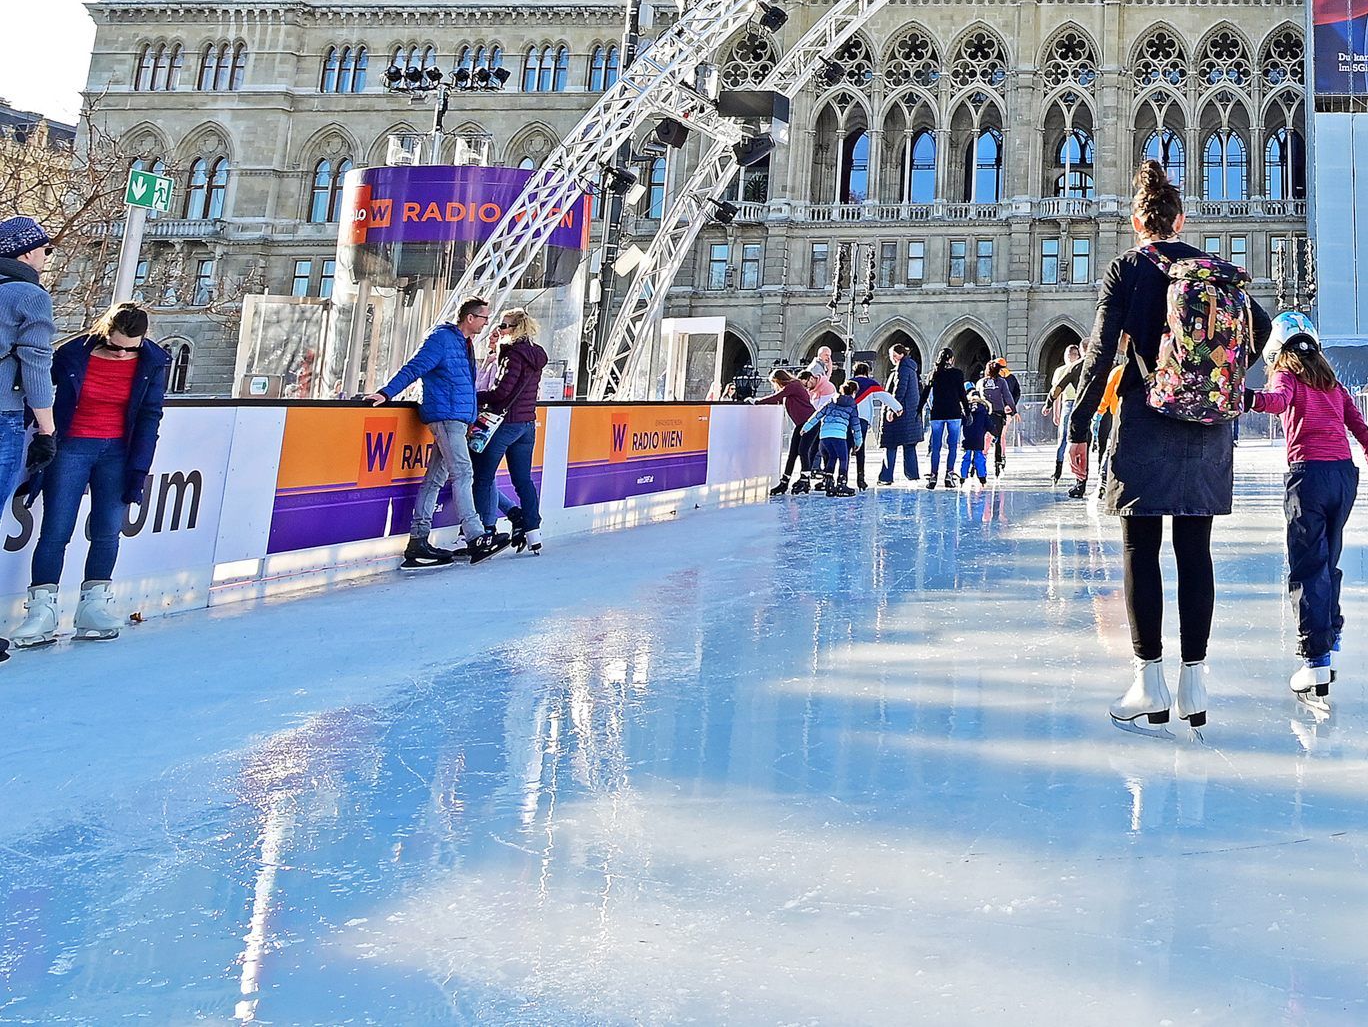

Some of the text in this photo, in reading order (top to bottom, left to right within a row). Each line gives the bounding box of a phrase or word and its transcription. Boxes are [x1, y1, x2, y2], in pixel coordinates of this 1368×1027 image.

[1338, 52, 1351, 62] Du
[1338, 63, 1350, 72] Im
[402, 201, 502, 223] RADIO
[612, 423, 683, 452] W RADIO WIEN
[366, 432, 394, 472] W
